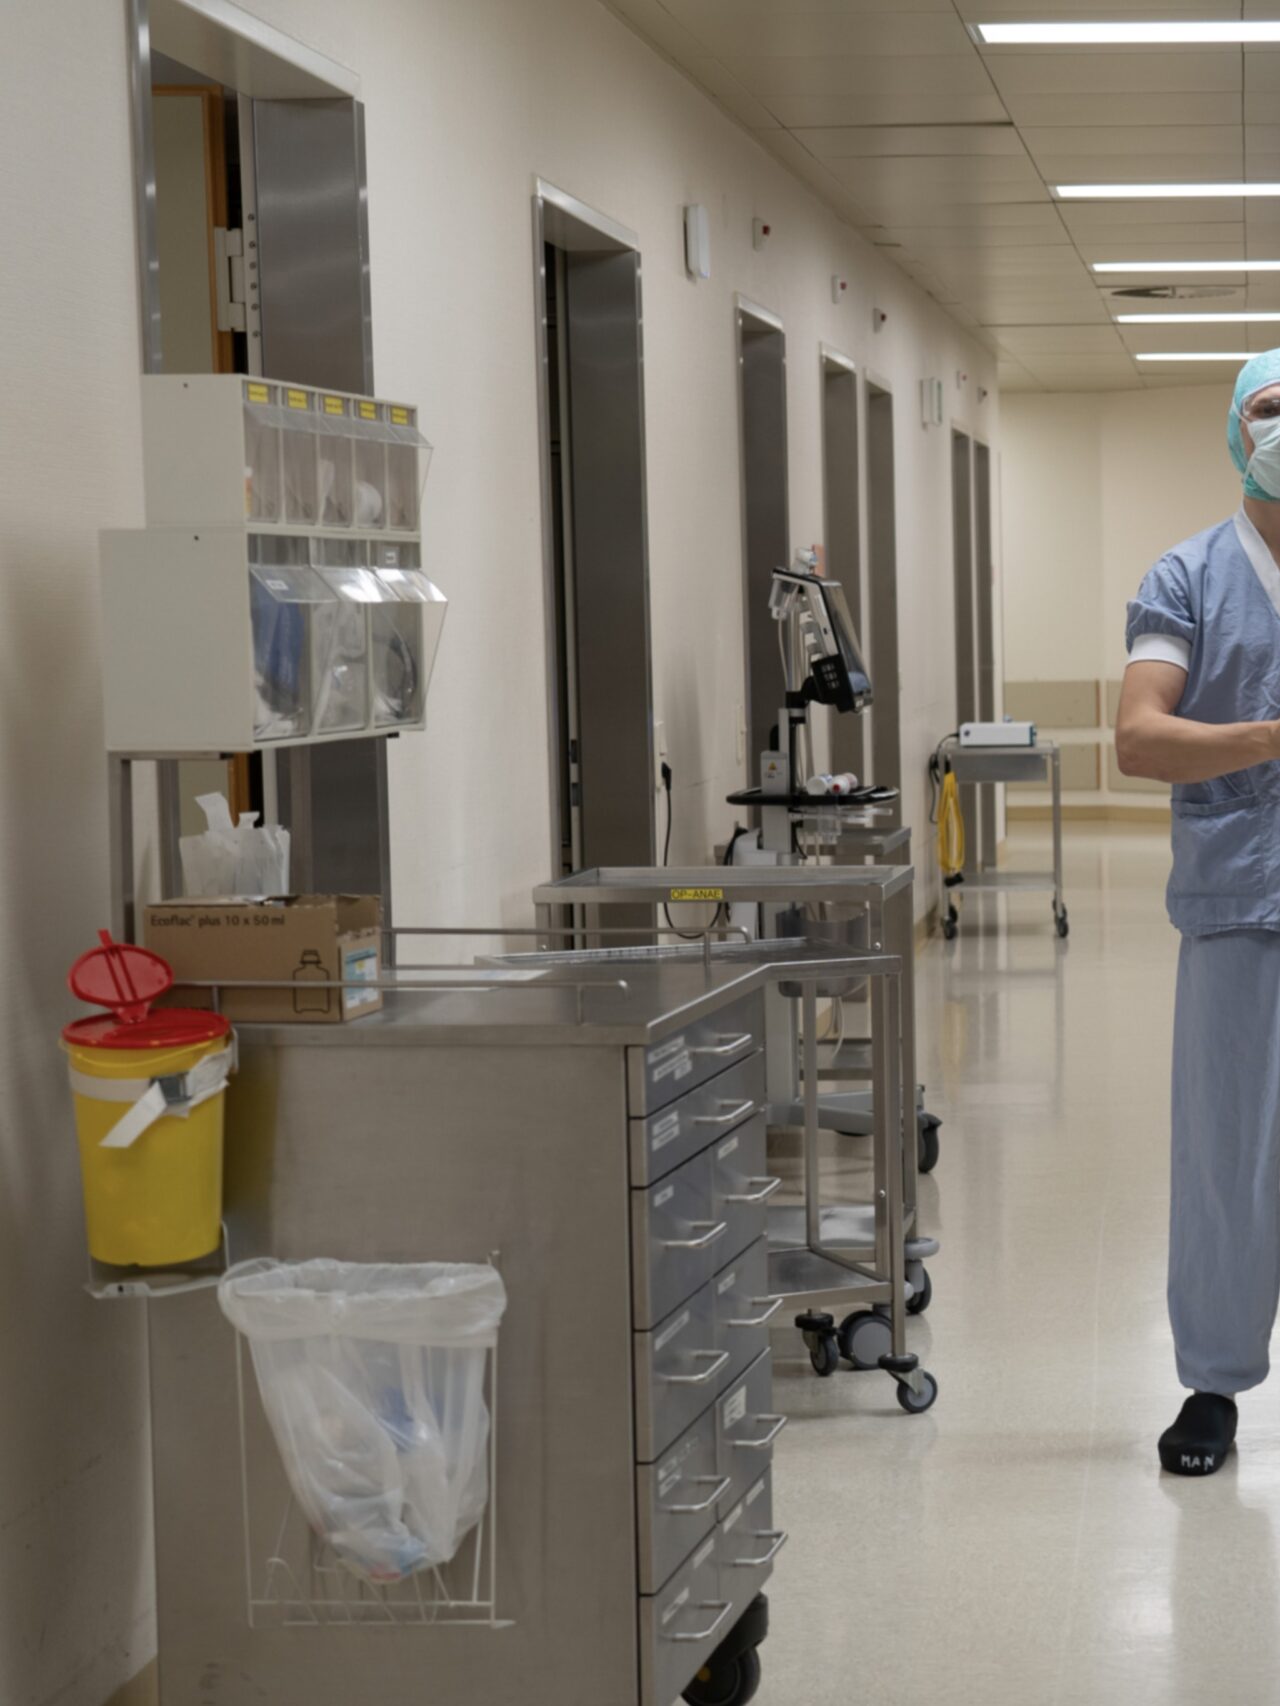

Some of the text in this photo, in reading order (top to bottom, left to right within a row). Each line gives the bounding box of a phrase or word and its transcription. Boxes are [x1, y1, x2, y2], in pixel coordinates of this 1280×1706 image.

[198, 914, 221, 928] plus
[225, 914, 240, 926] 10
[243, 917, 251, 926] x
